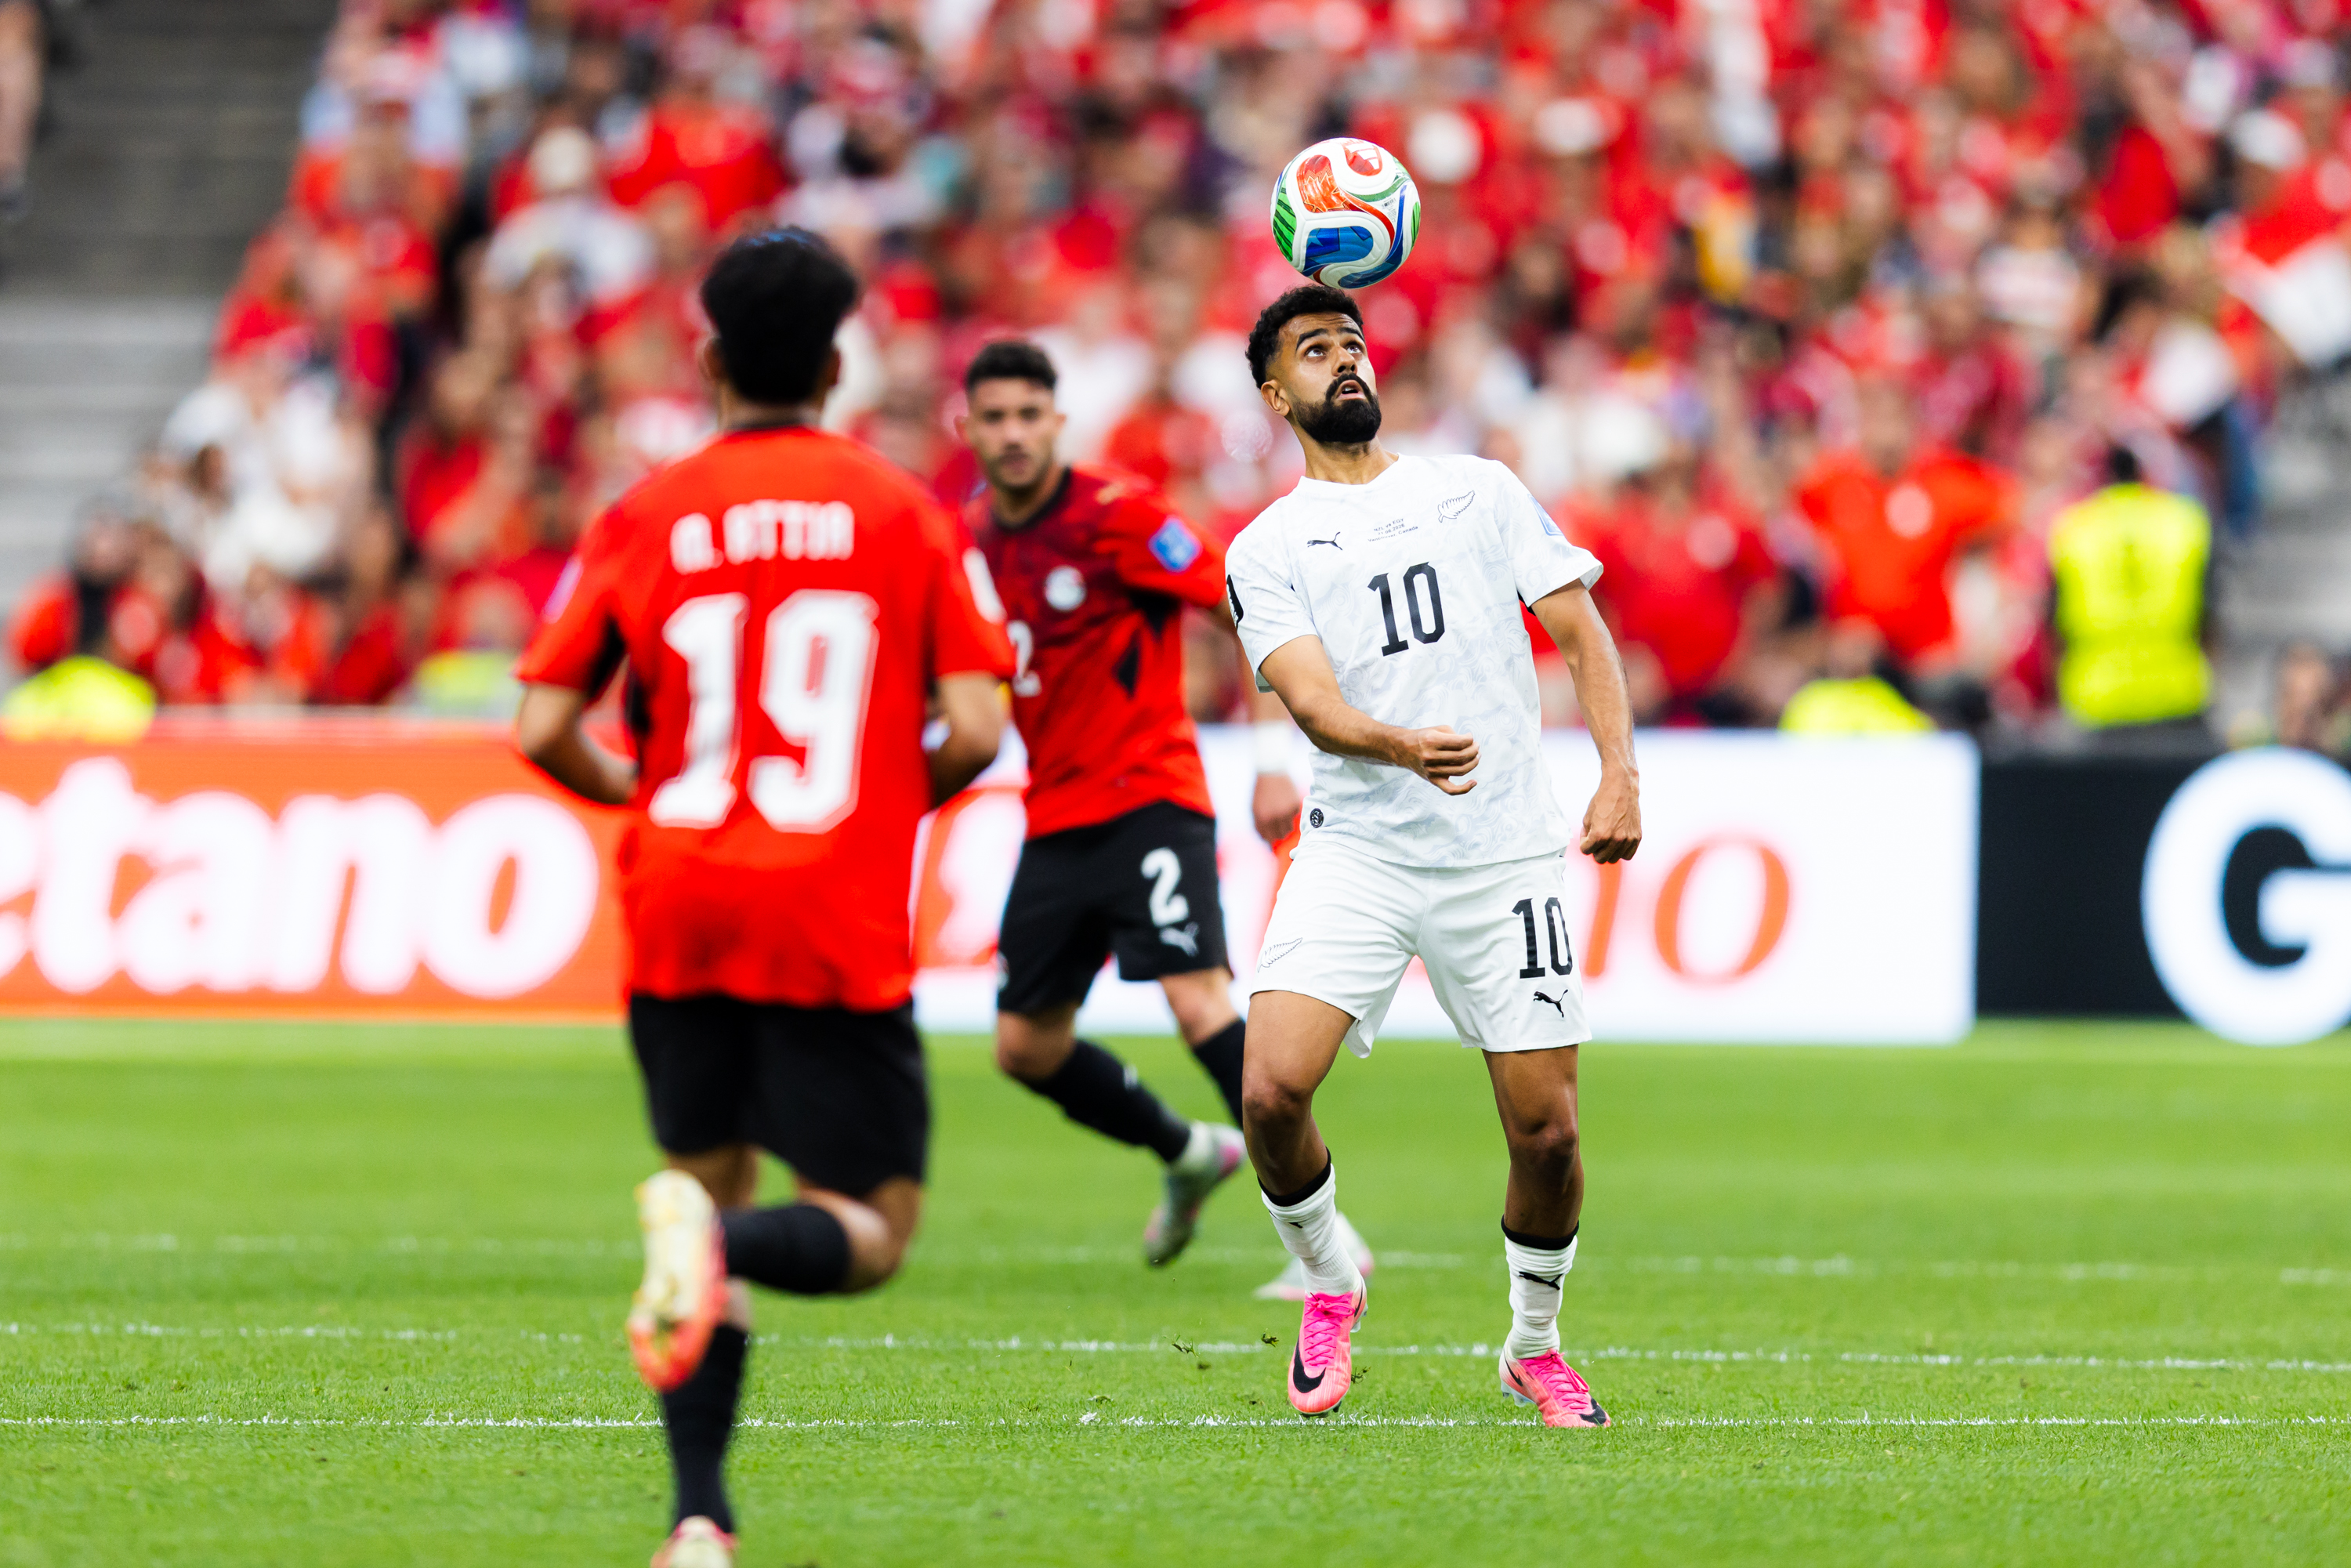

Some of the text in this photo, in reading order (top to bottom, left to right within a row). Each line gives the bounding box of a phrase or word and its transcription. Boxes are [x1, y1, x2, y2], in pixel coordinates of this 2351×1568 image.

[1398, 526, 1418, 534] Canada
[1367, 562, 1445, 657] 10
[649, 588, 878, 835] 19
[1141, 847, 1189, 925] 2
[2141, 746, 2351, 1045] G
[1512, 896, 1573, 979] 10
